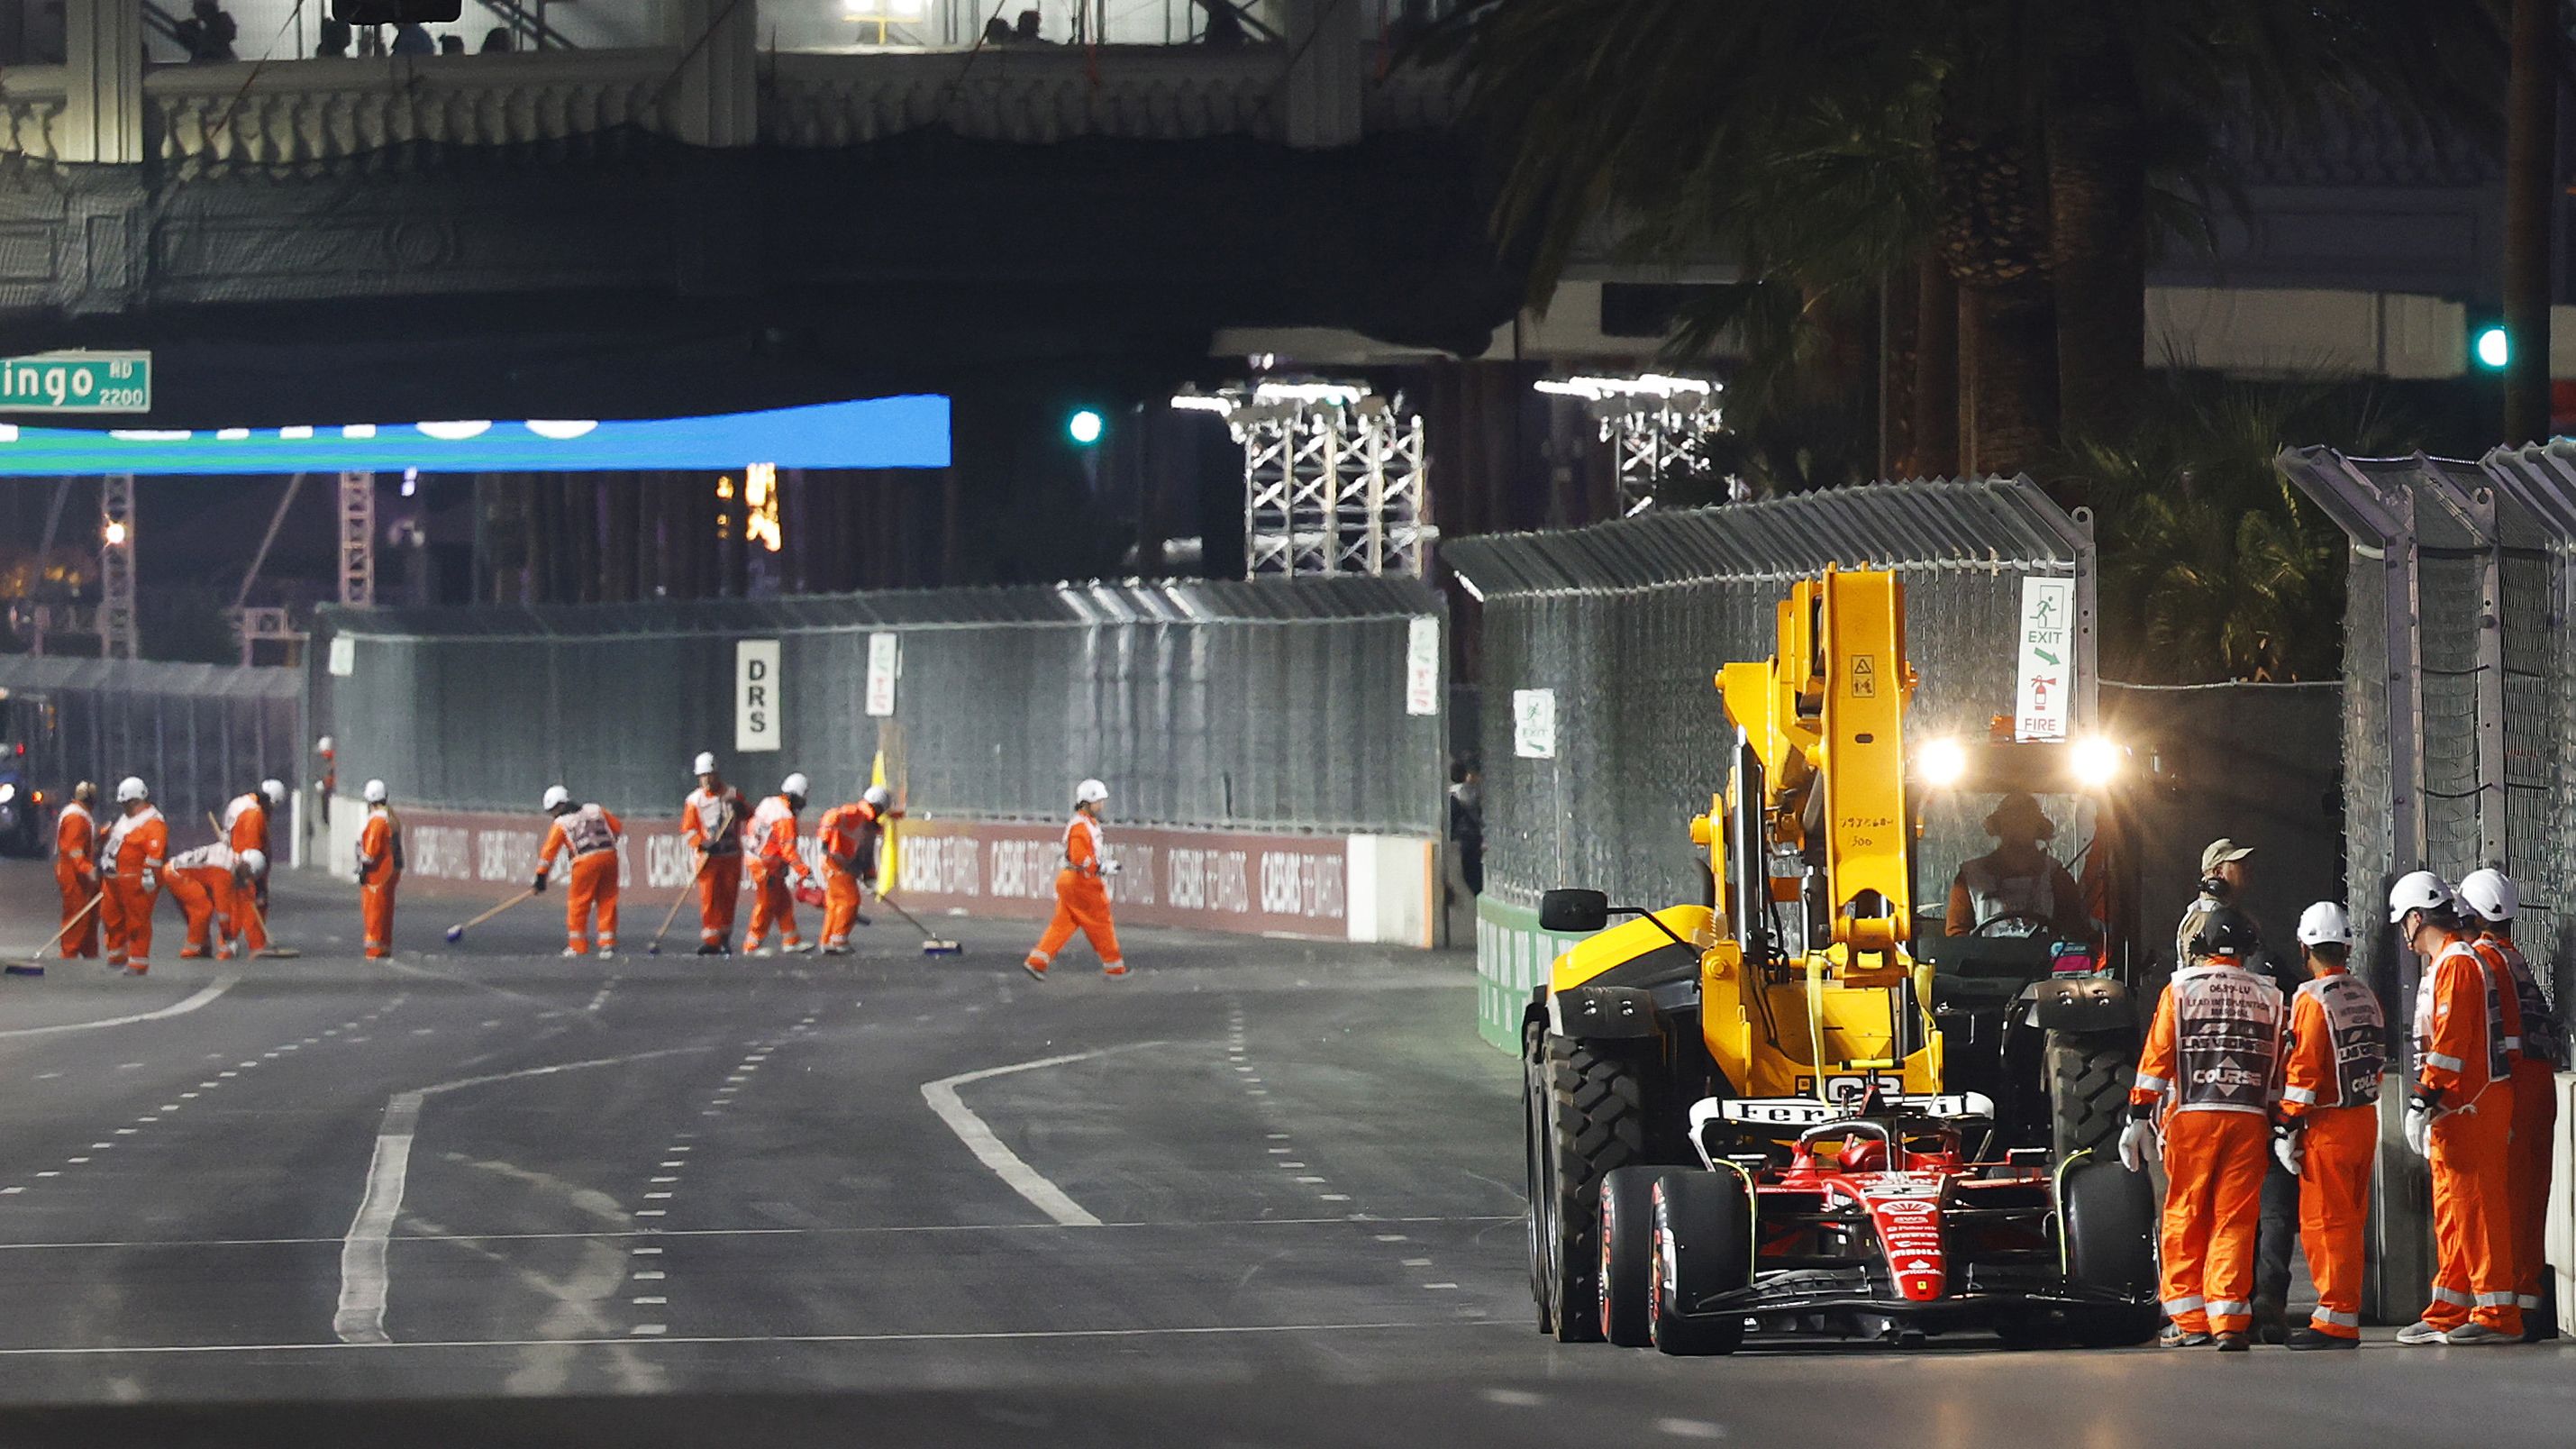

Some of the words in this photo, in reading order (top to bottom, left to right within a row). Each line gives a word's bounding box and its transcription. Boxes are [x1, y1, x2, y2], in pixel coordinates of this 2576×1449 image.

[4, 360, 93, 406] ingo
[99, 388, 143, 406] 2200
[2027, 631, 2062, 644] EXIT
[748, 659, 766, 734] DRS
[1523, 727, 1547, 737] EXIT
[2024, 717, 2056, 732] FIRE
[2192, 1068, 2262, 1088] COURSE
